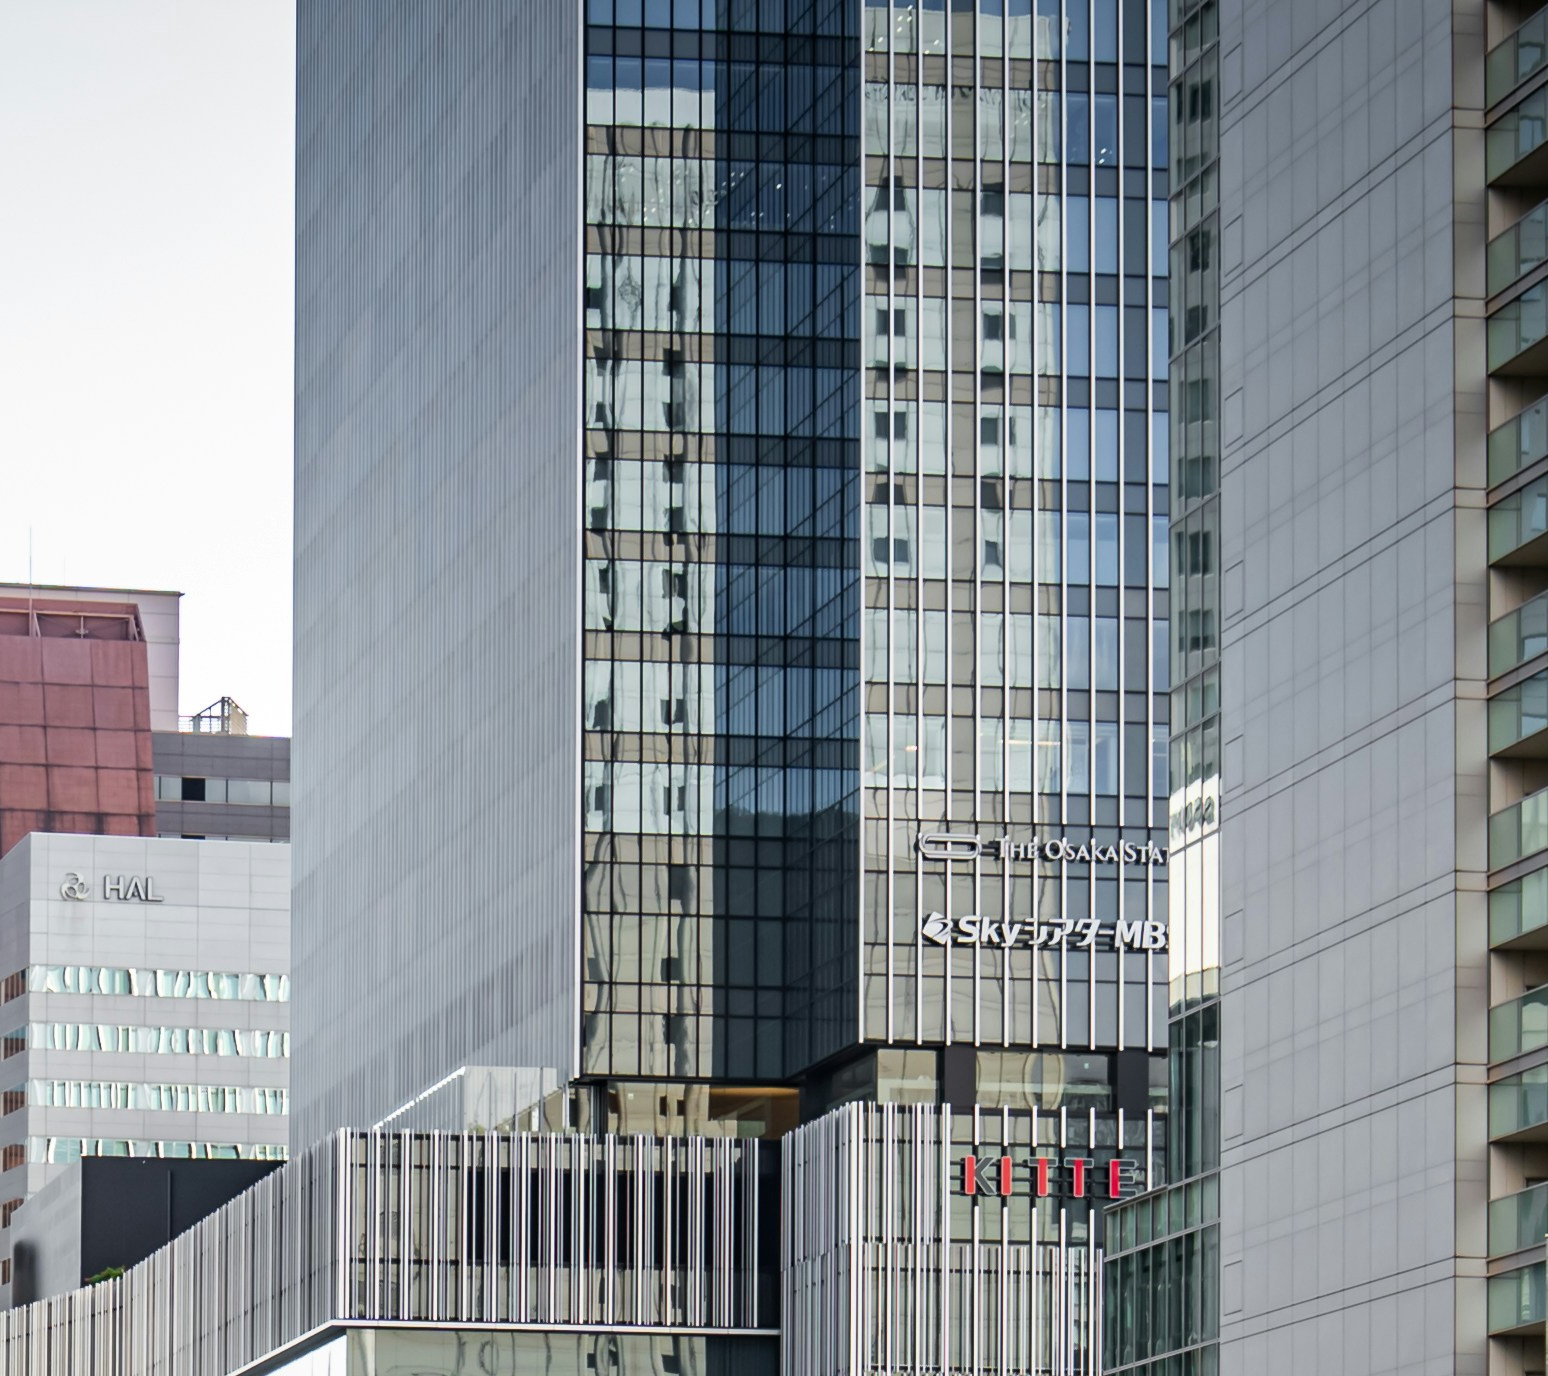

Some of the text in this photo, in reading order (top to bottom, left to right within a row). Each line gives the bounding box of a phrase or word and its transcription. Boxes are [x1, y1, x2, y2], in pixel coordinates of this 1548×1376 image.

[996, 838, 1038, 860] THE
[1045, 839, 1118, 862] OSAKA
[104, 875, 164, 902] HAL
[957, 914, 1169, 950] SkyシアターMB
[964, 1155, 1139, 1199] KITTE
